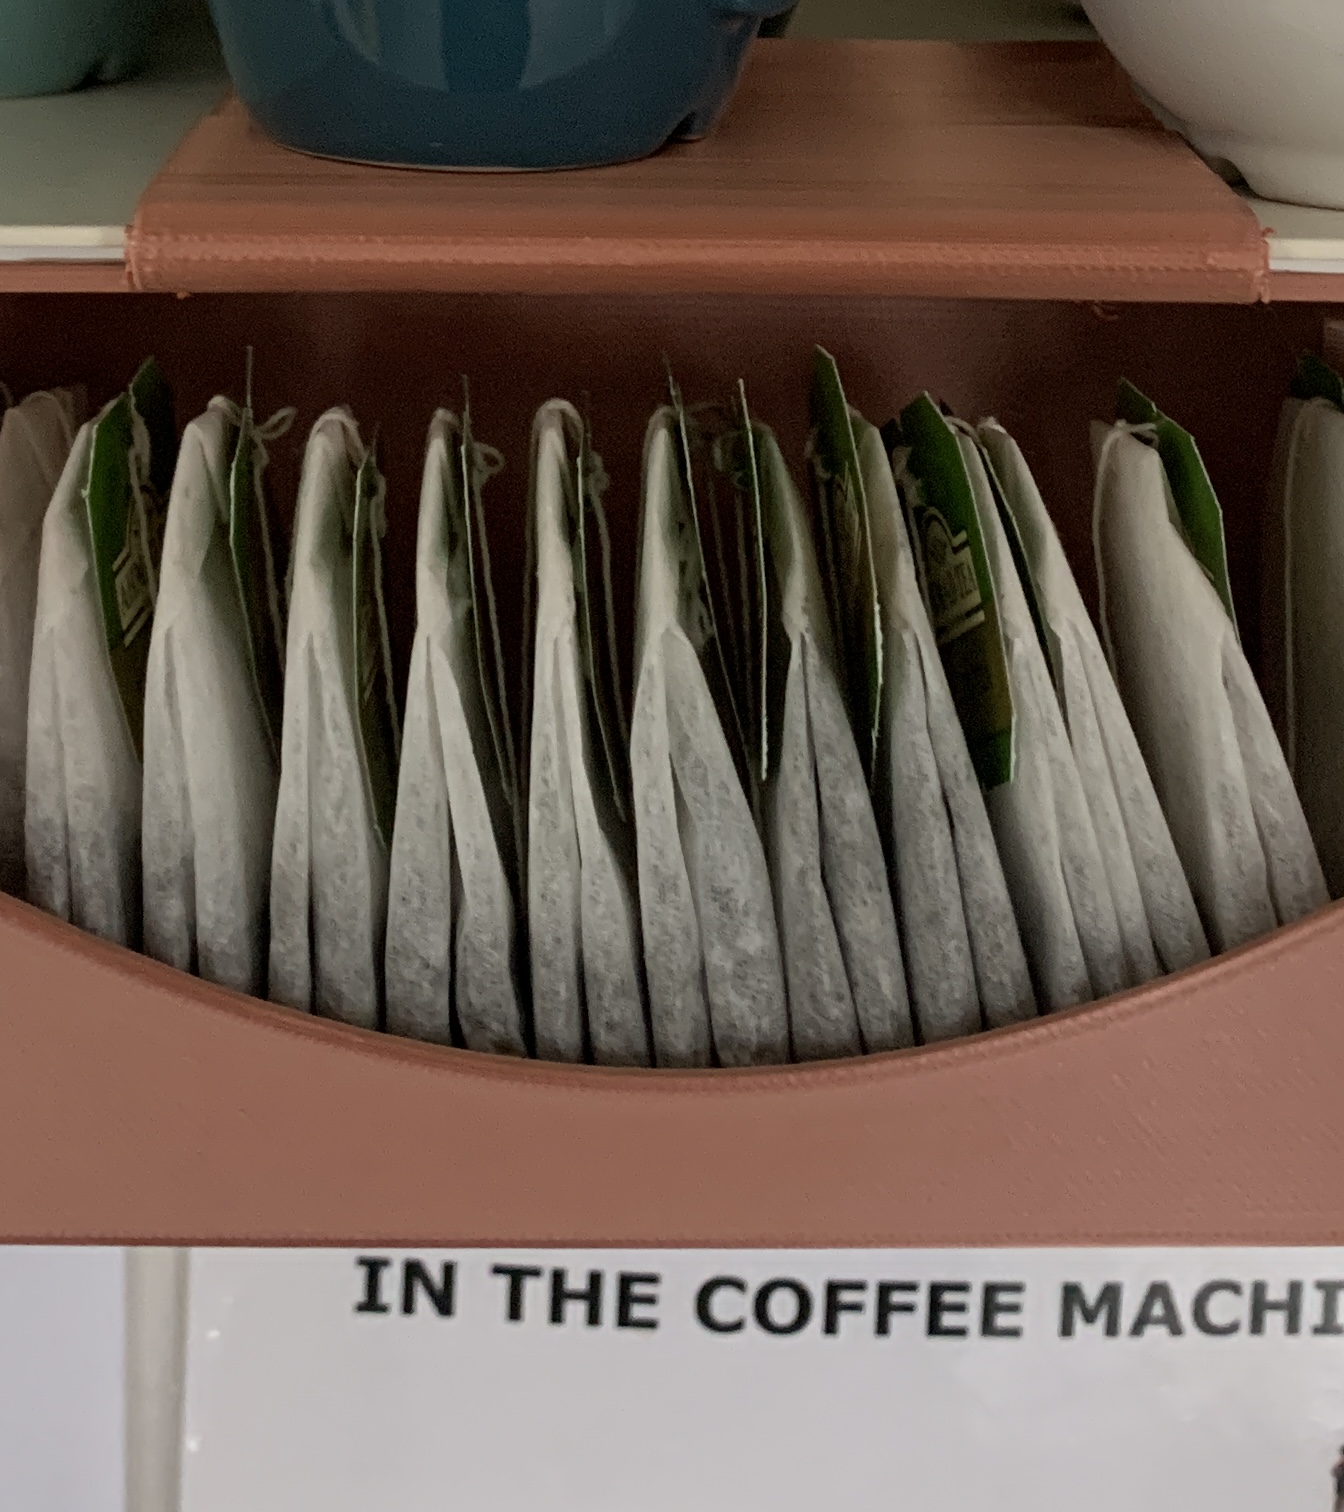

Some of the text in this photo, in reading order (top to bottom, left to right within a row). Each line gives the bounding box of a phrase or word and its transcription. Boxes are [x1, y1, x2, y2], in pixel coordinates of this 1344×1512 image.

[355, 1256, 457, 1318] IN
[490, 1263, 661, 1330] THE
[695, 1276, 1025, 1338] COFFEE
